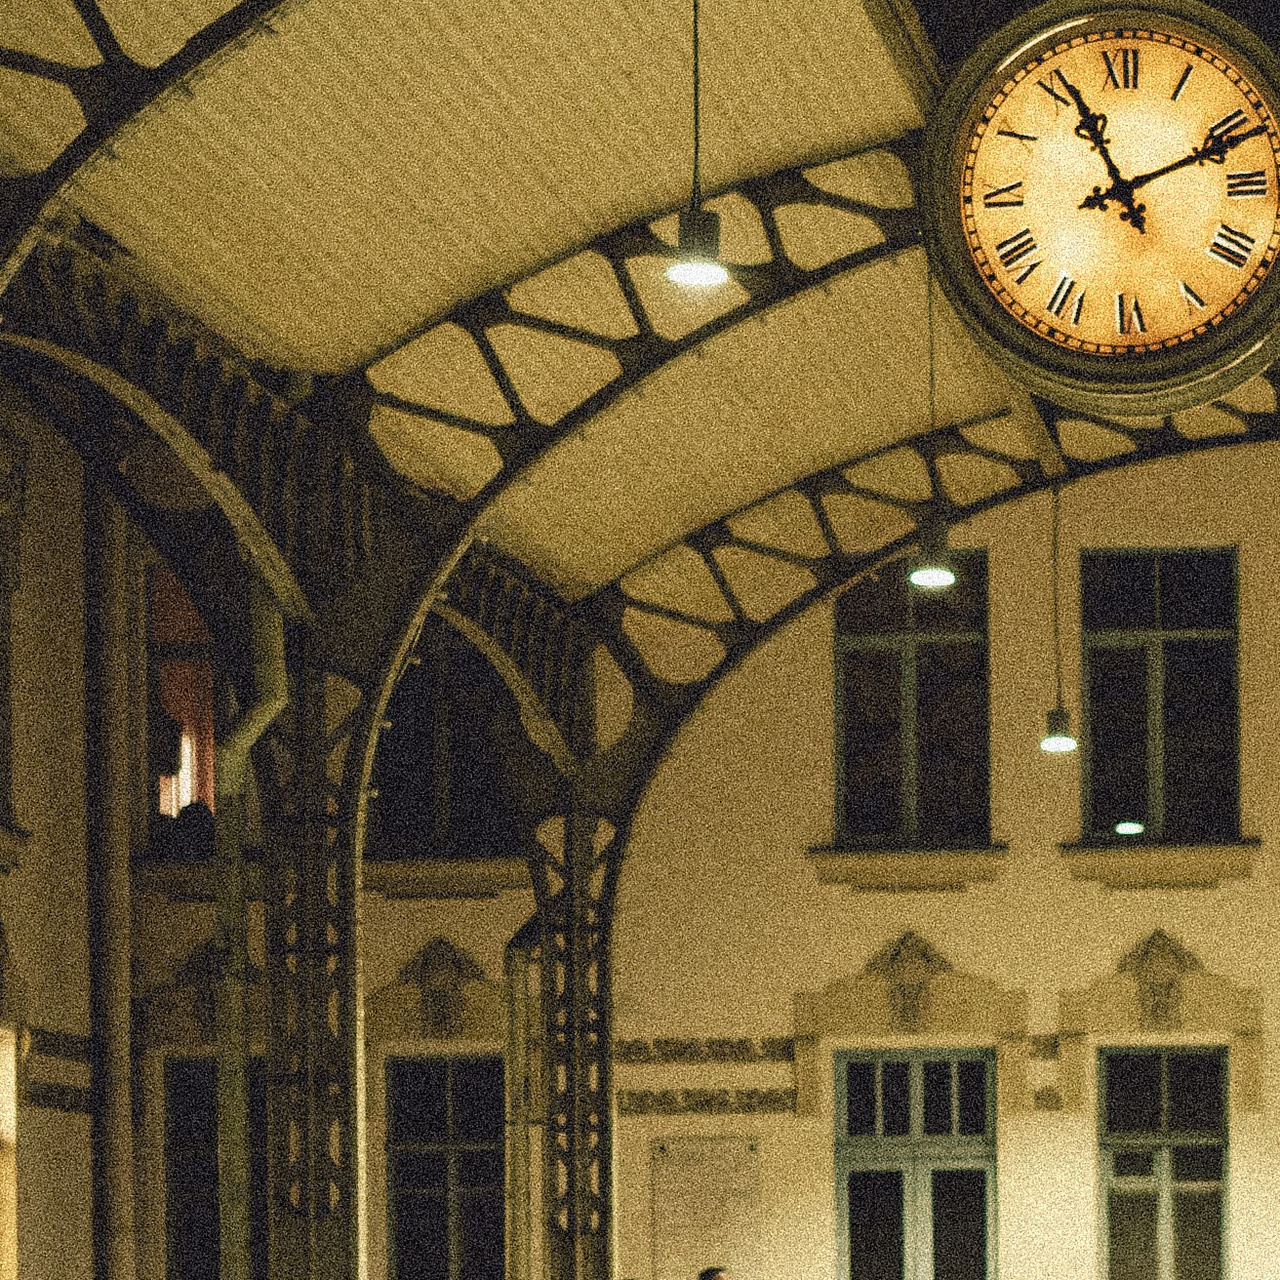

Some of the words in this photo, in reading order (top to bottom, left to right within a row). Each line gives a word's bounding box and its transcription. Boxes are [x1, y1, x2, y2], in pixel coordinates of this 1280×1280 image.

[1101, 48, 1139, 92] XII
[1171, 64, 1193, 101] I
[1226, 170, 1267, 198] III
[995, 228, 1043, 285] VIII
[1208, 223, 1256, 269] IIII
[1046, 276, 1086, 325] VII
[1118, 292, 1147, 336] VI
